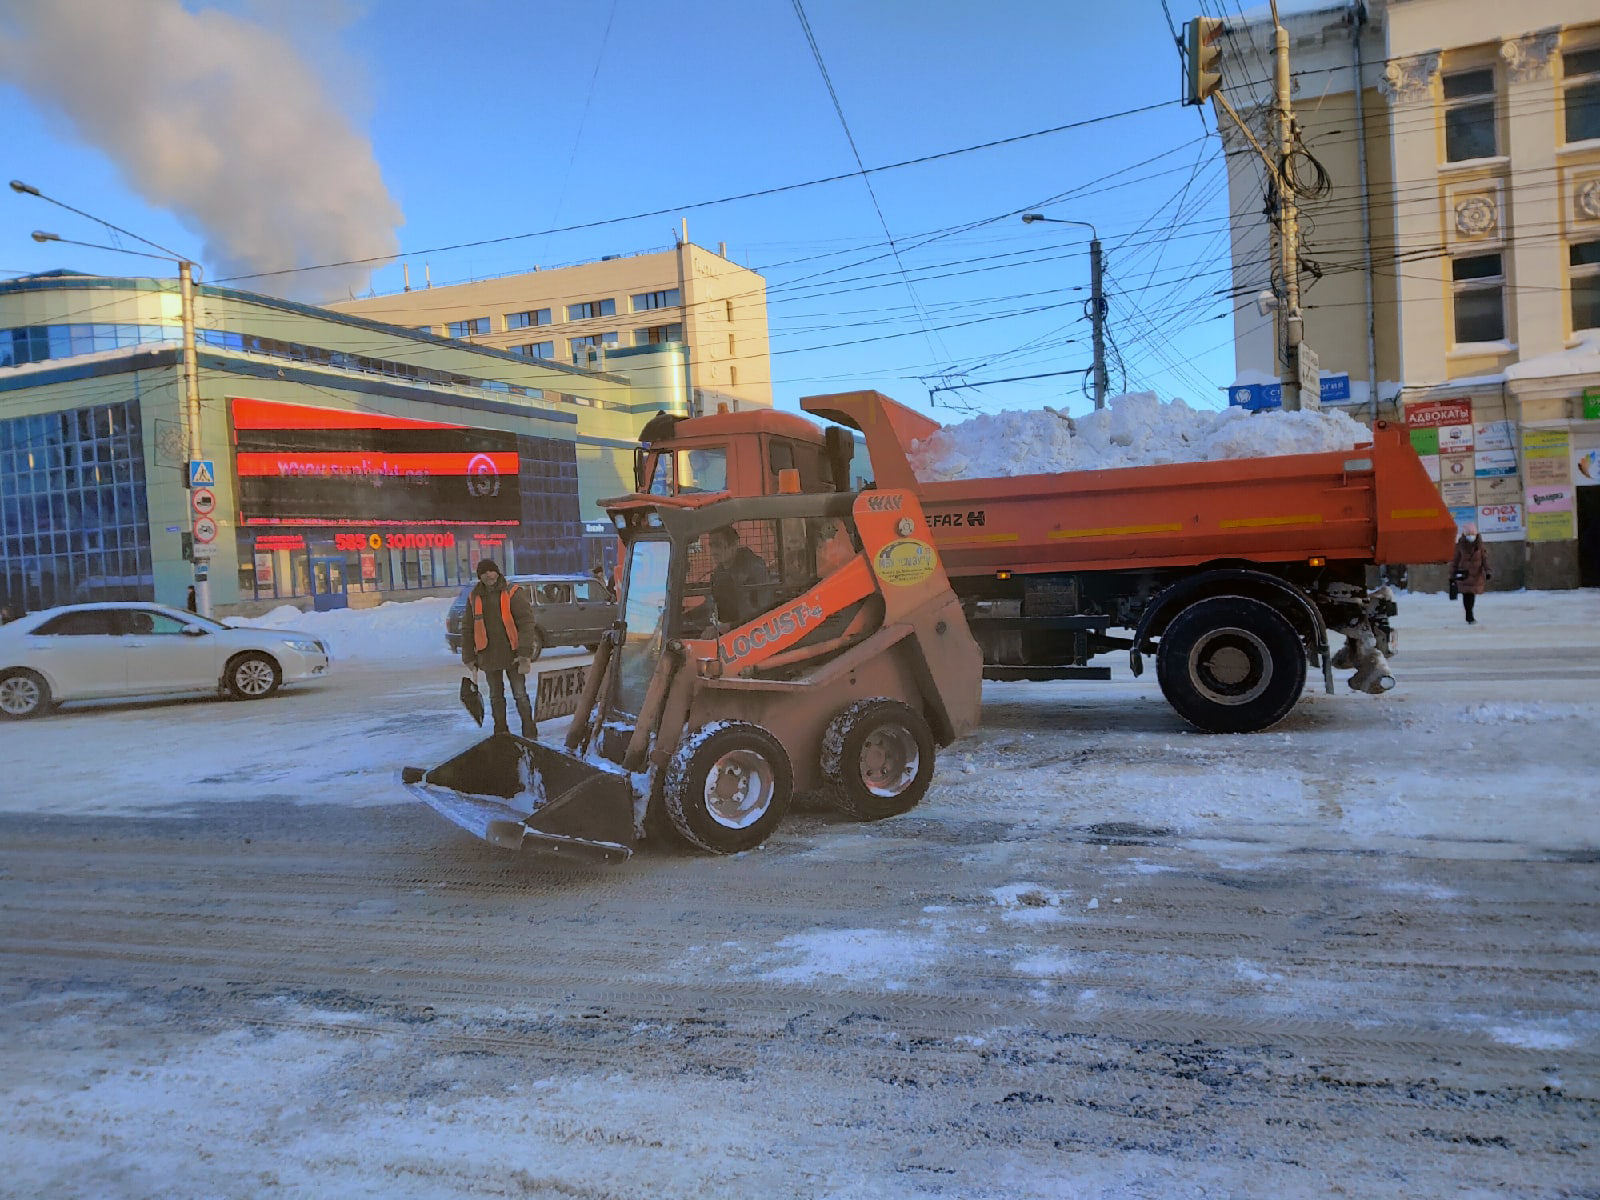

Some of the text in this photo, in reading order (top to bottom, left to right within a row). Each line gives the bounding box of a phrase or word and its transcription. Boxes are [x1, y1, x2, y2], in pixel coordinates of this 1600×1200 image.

[1408, 409, 1469, 423] АДВОКАТЫ
[1482, 505, 1517, 516] anex
[925, 513, 963, 528] EFAZ
[335, 531, 455, 551] 585 ЗОЛОТОЙ
[720, 604, 807, 664] LOCUST
